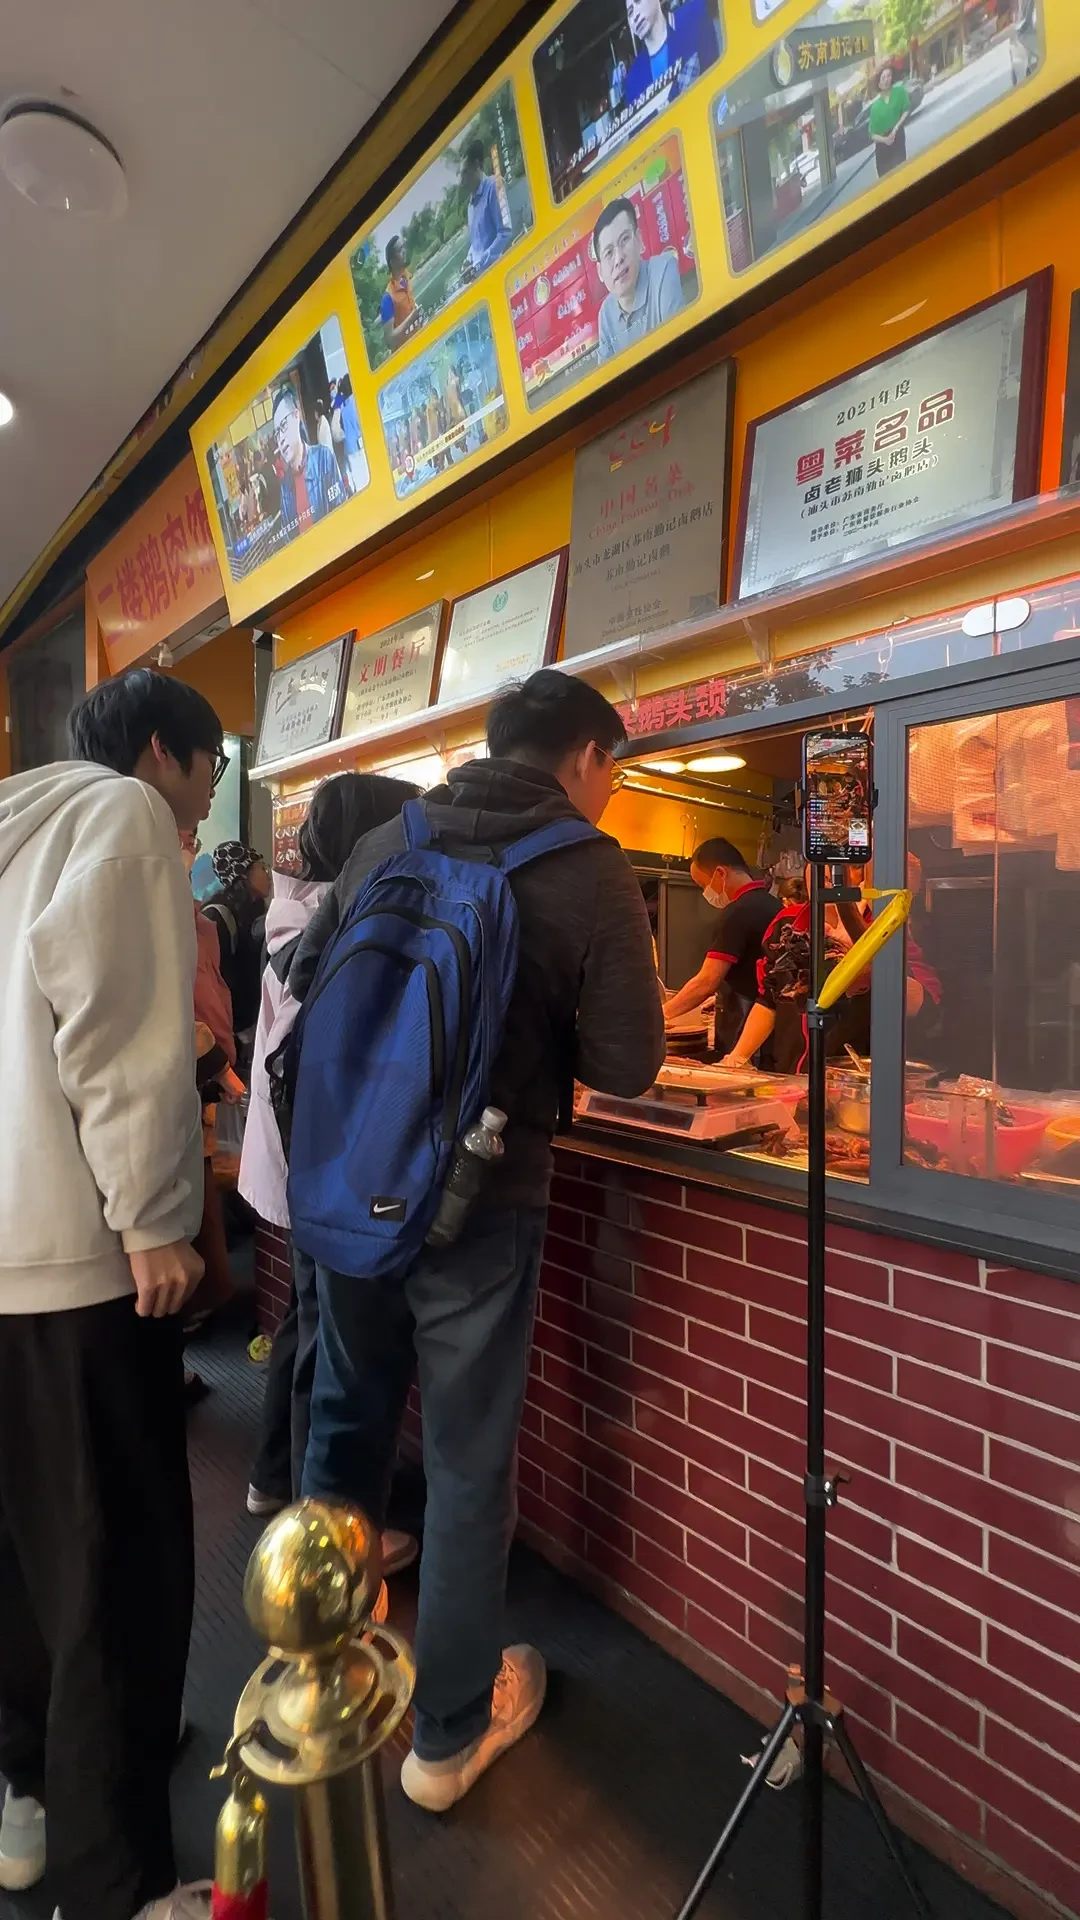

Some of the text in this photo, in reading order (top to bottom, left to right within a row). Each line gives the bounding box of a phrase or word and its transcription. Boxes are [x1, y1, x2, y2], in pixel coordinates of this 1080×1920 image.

[836, 379, 911, 426] 2021年度
[796, 388, 954, 486] 粤菜名品
[804, 438, 932, 504] 卤老狮头鹅头
[356, 636, 425, 687] 文明餐厅
